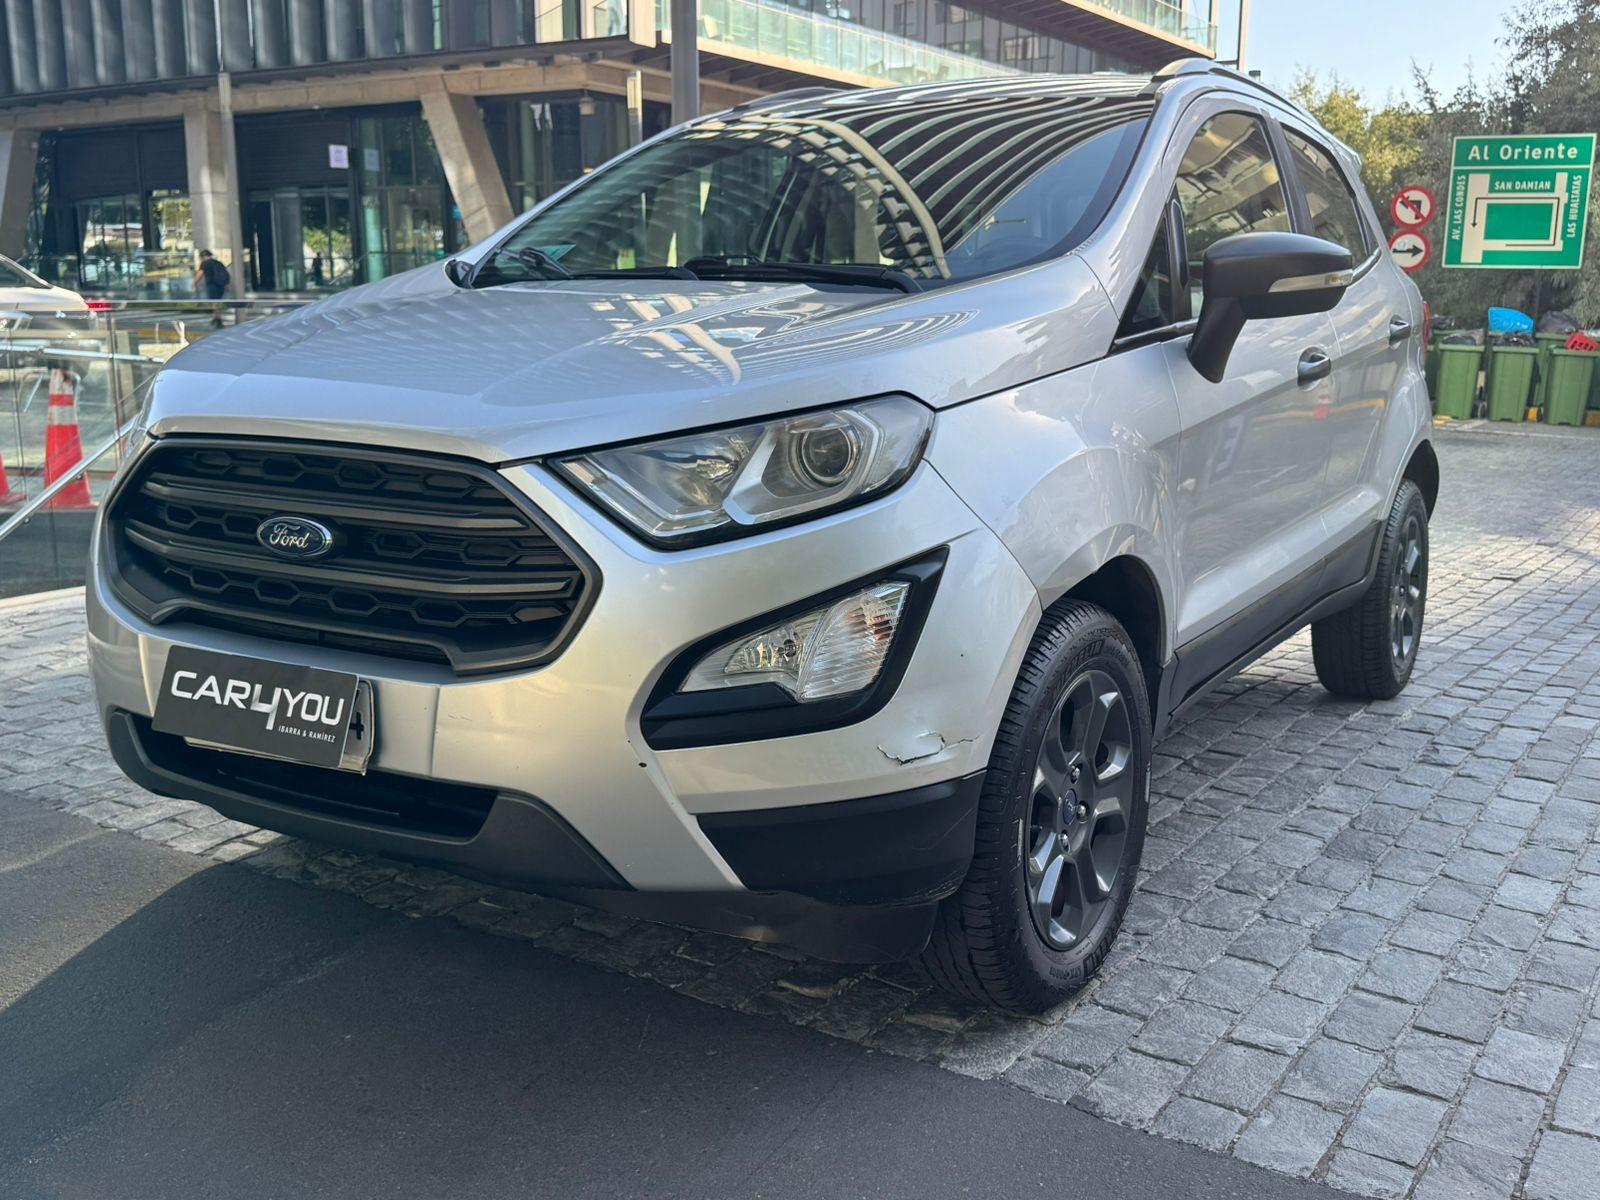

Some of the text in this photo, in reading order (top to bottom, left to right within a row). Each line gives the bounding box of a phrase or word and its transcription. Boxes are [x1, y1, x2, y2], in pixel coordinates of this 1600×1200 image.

[1468, 143, 1578, 160] Al Oriente
[1494, 180, 1551, 190] SAN DAMIAN
[1451, 174, 1466, 240] AV. LAS CONDES
[1566, 174, 1582, 238] LAS HUALTATAS
[269, 523, 310, 548] Ford
[278, 724, 337, 744] IBARRA & RAMÍREZ
